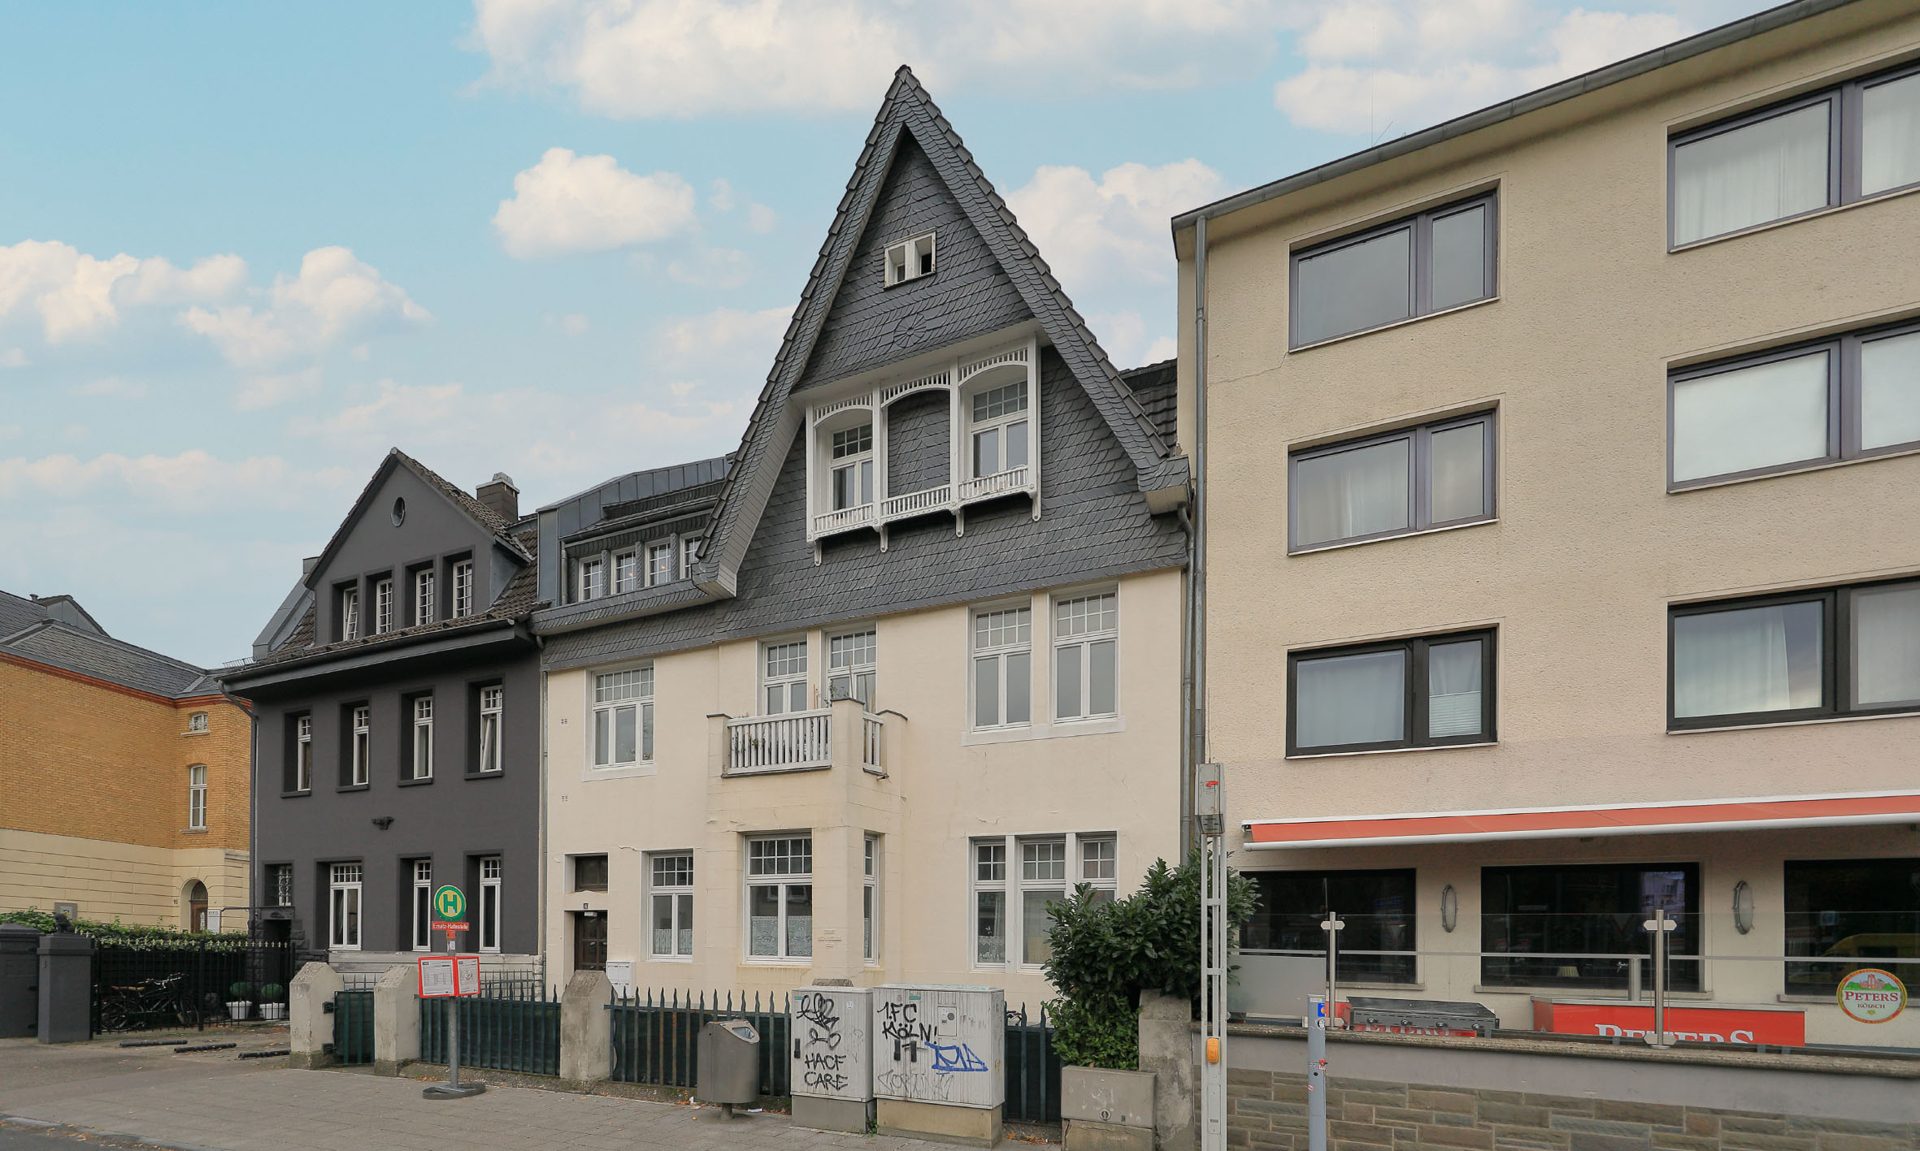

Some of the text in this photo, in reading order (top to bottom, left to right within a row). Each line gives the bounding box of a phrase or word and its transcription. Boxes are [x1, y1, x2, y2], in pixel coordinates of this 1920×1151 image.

[443, 894, 458, 913] H
[1845, 991, 1899, 1002] PETERS
[804, 1072, 849, 1091] CARE
